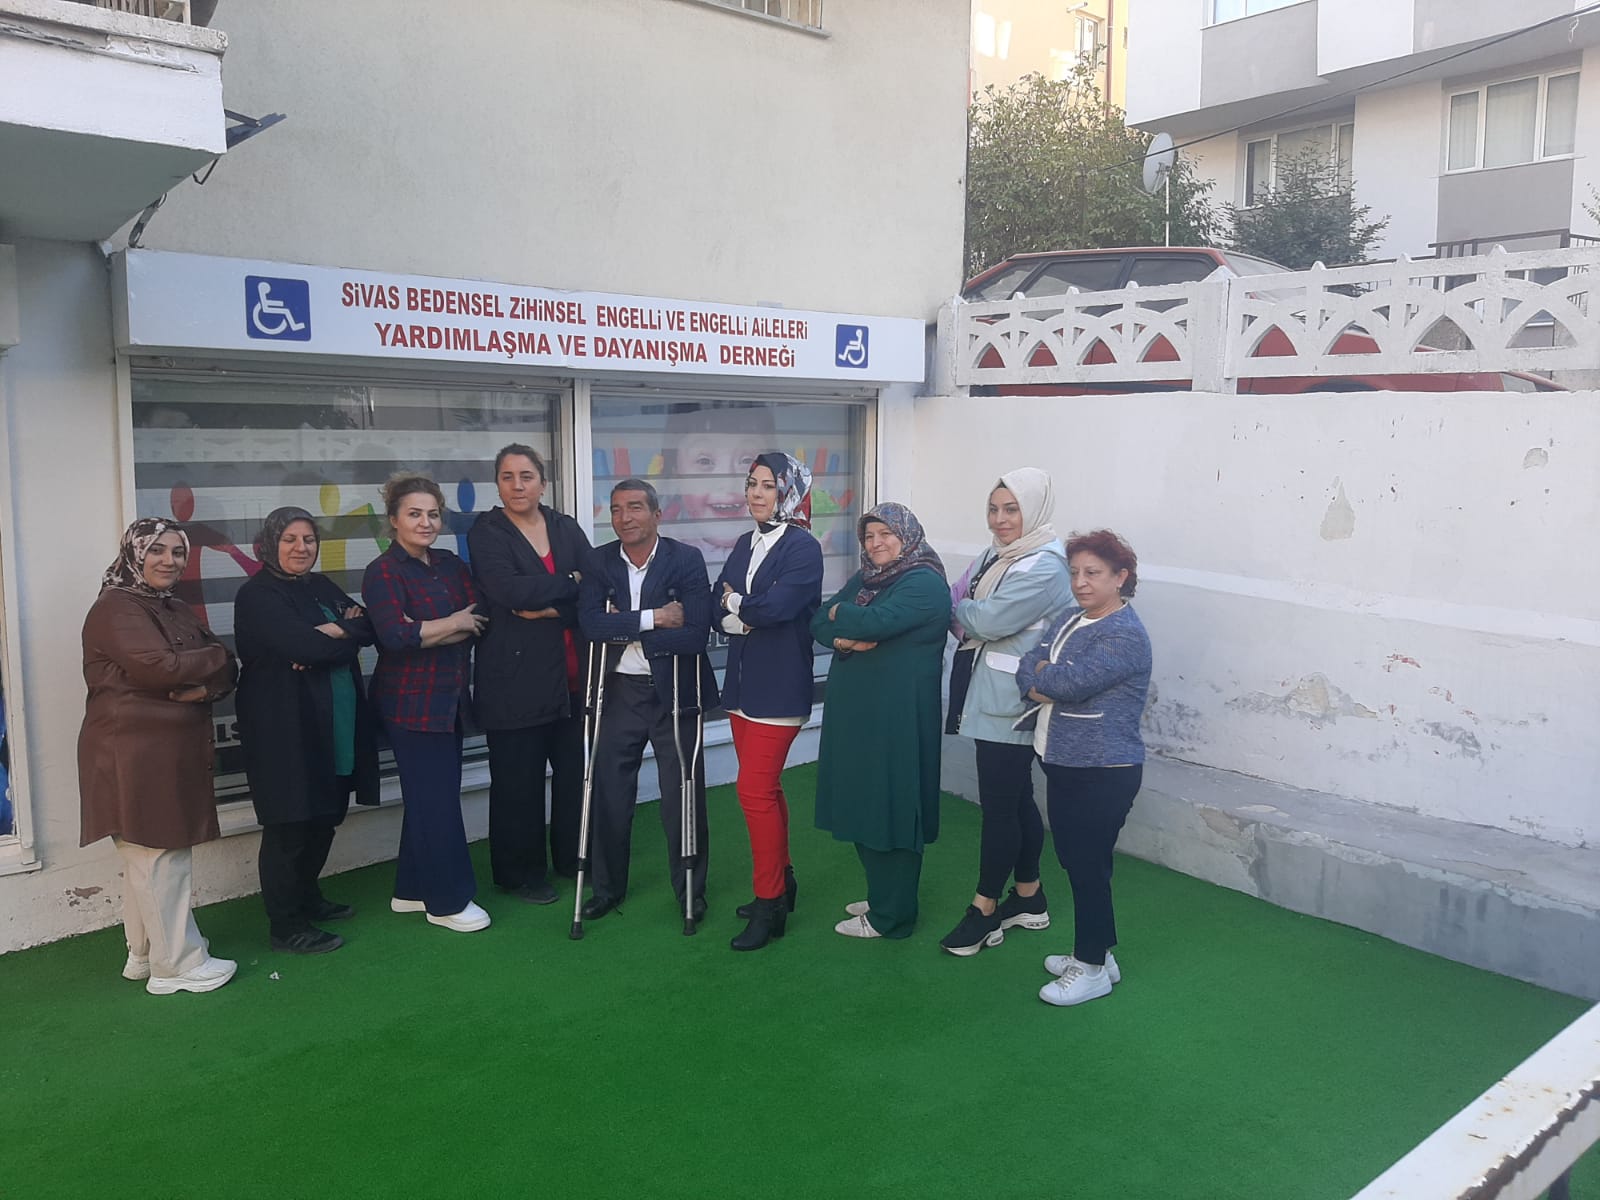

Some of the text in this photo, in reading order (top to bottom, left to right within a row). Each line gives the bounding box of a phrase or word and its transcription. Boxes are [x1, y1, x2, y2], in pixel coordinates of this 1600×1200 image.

[406, 287, 505, 319] BEDENSEL
[666, 310, 685, 333] VE
[374, 321, 552, 359] YARDIMLAŞMA
[557, 334, 587, 358] VE
[593, 336, 708, 368] DAYANIŞMA
